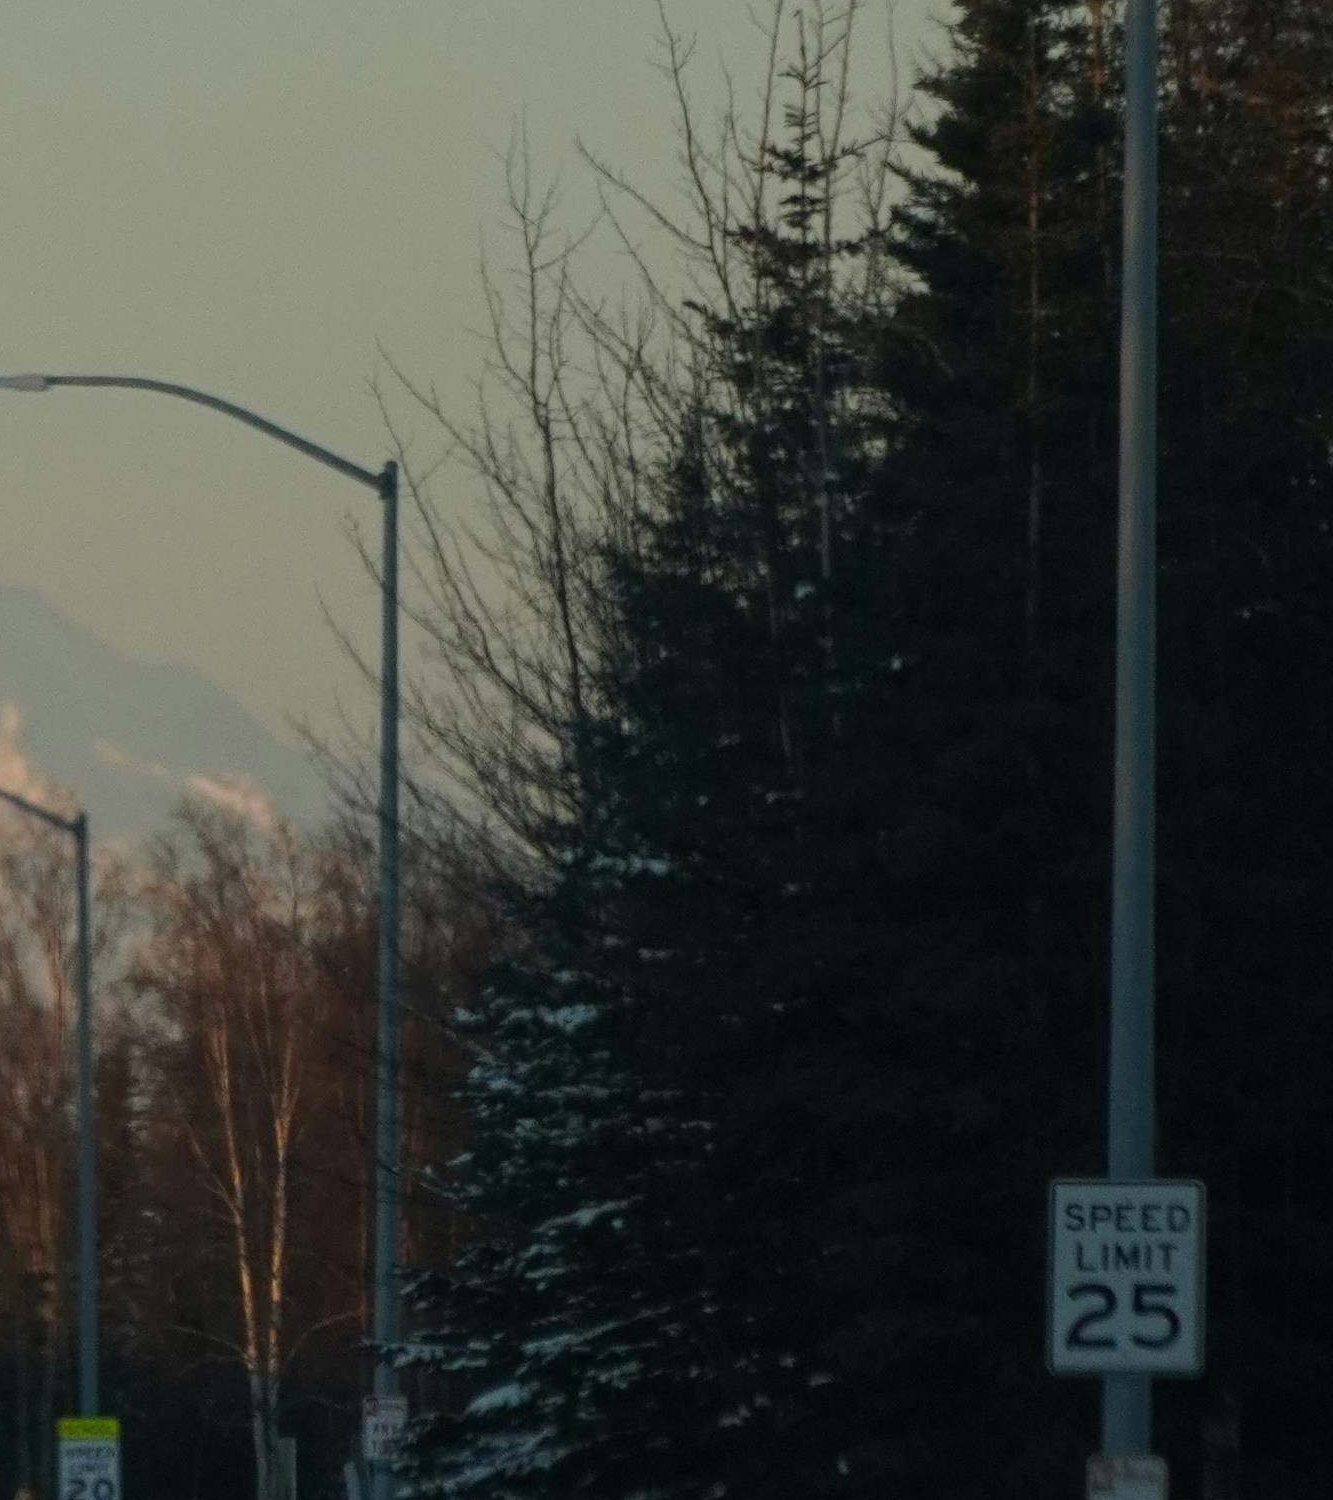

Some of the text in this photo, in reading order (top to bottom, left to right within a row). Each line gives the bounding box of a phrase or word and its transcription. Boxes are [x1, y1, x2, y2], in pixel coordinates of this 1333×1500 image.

[1064, 1202, 1191, 1233] SPEED
[1075, 1242, 1179, 1272] LIMIT
[1065, 1283, 1181, 1349] 25
